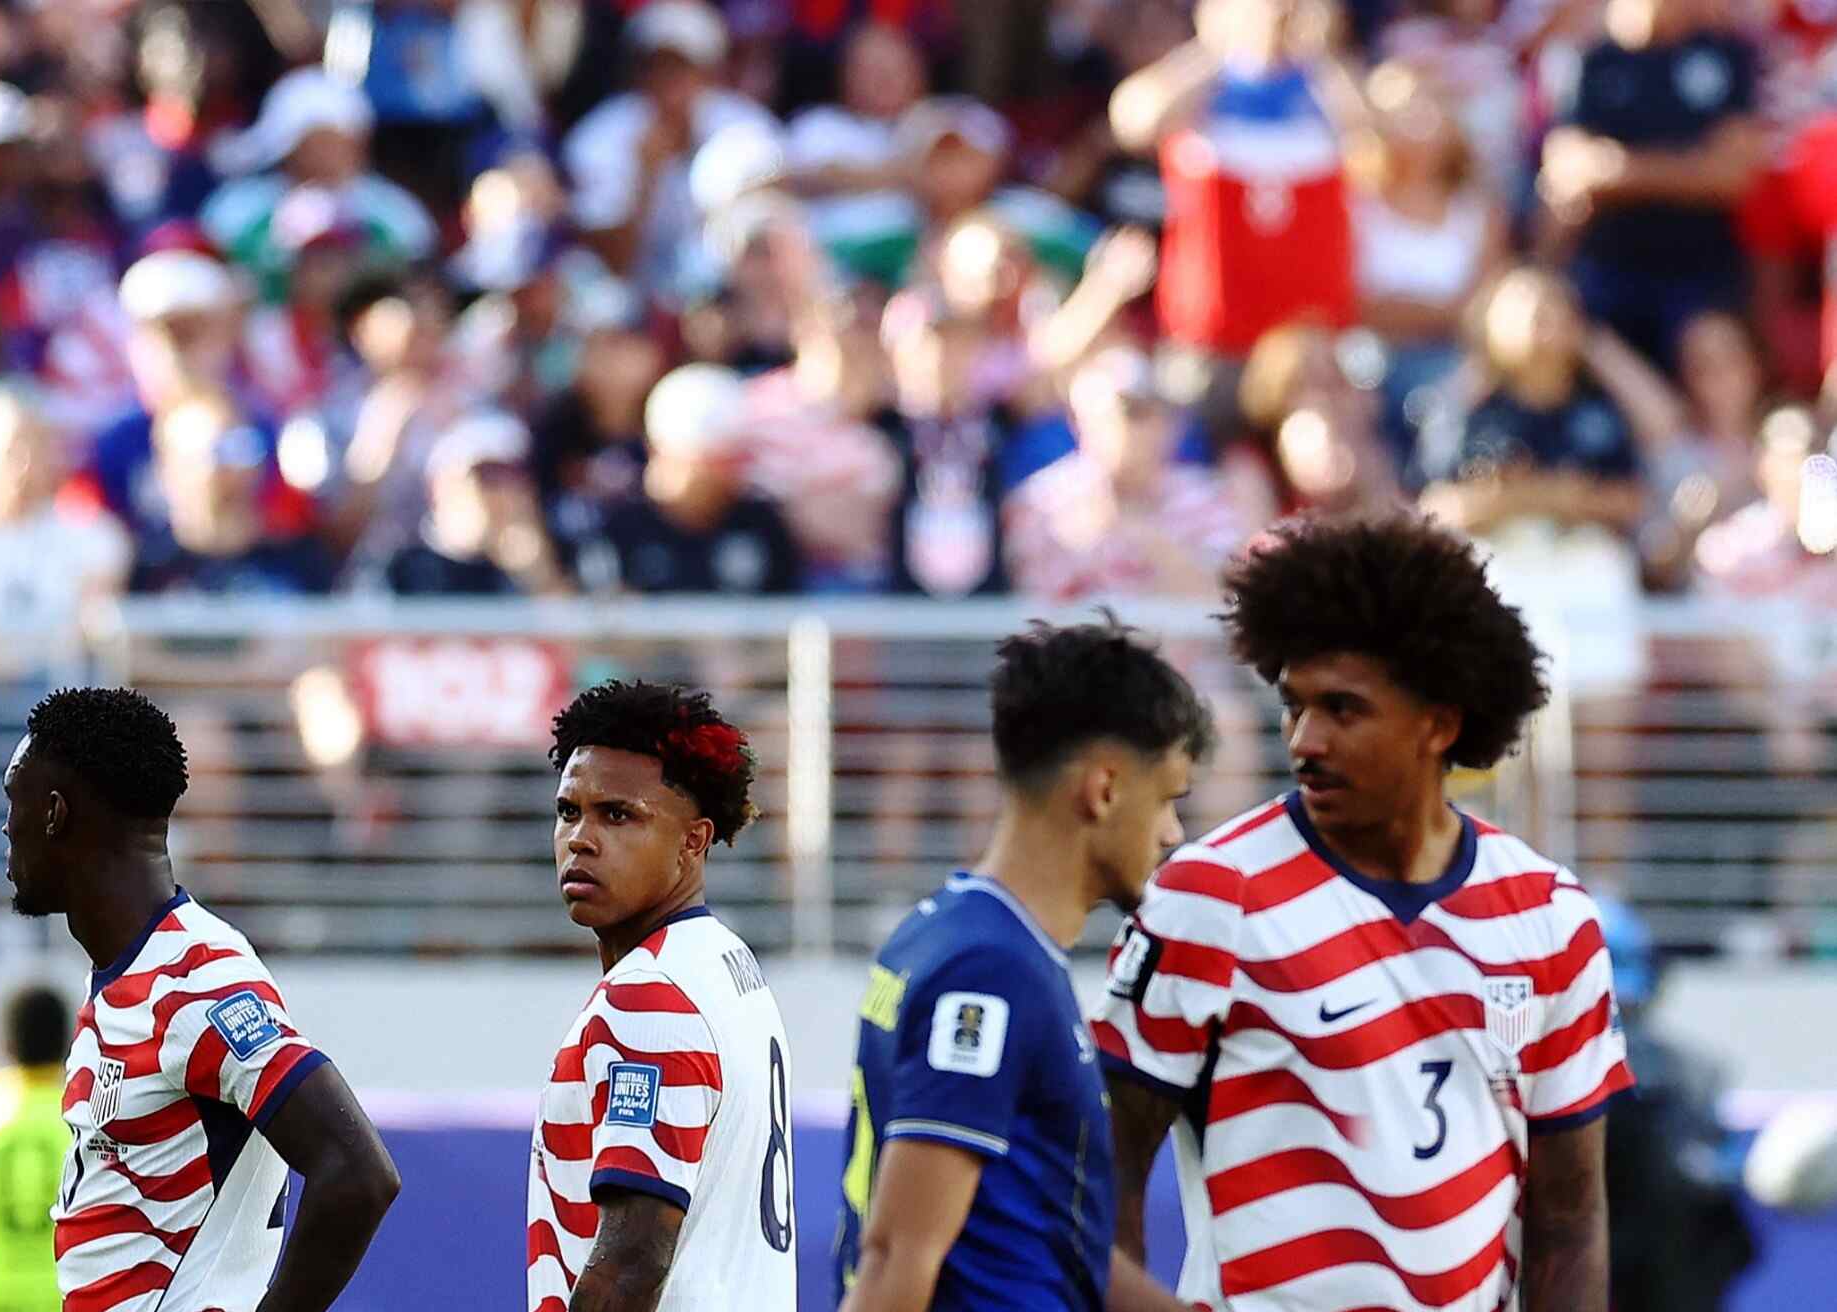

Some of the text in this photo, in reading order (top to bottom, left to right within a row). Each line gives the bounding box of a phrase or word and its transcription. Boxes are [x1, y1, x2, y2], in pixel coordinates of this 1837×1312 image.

[224, 1004, 260, 1031] UNITES
[98, 1061, 122, 1089] USA
[615, 1072, 650, 1085] FOOTBALL
[614, 1083, 650, 1099] UNITES
[622, 1096, 651, 1112] World
[1414, 1061, 1453, 1160] 3
[760, 1036, 792, 1253] 8
